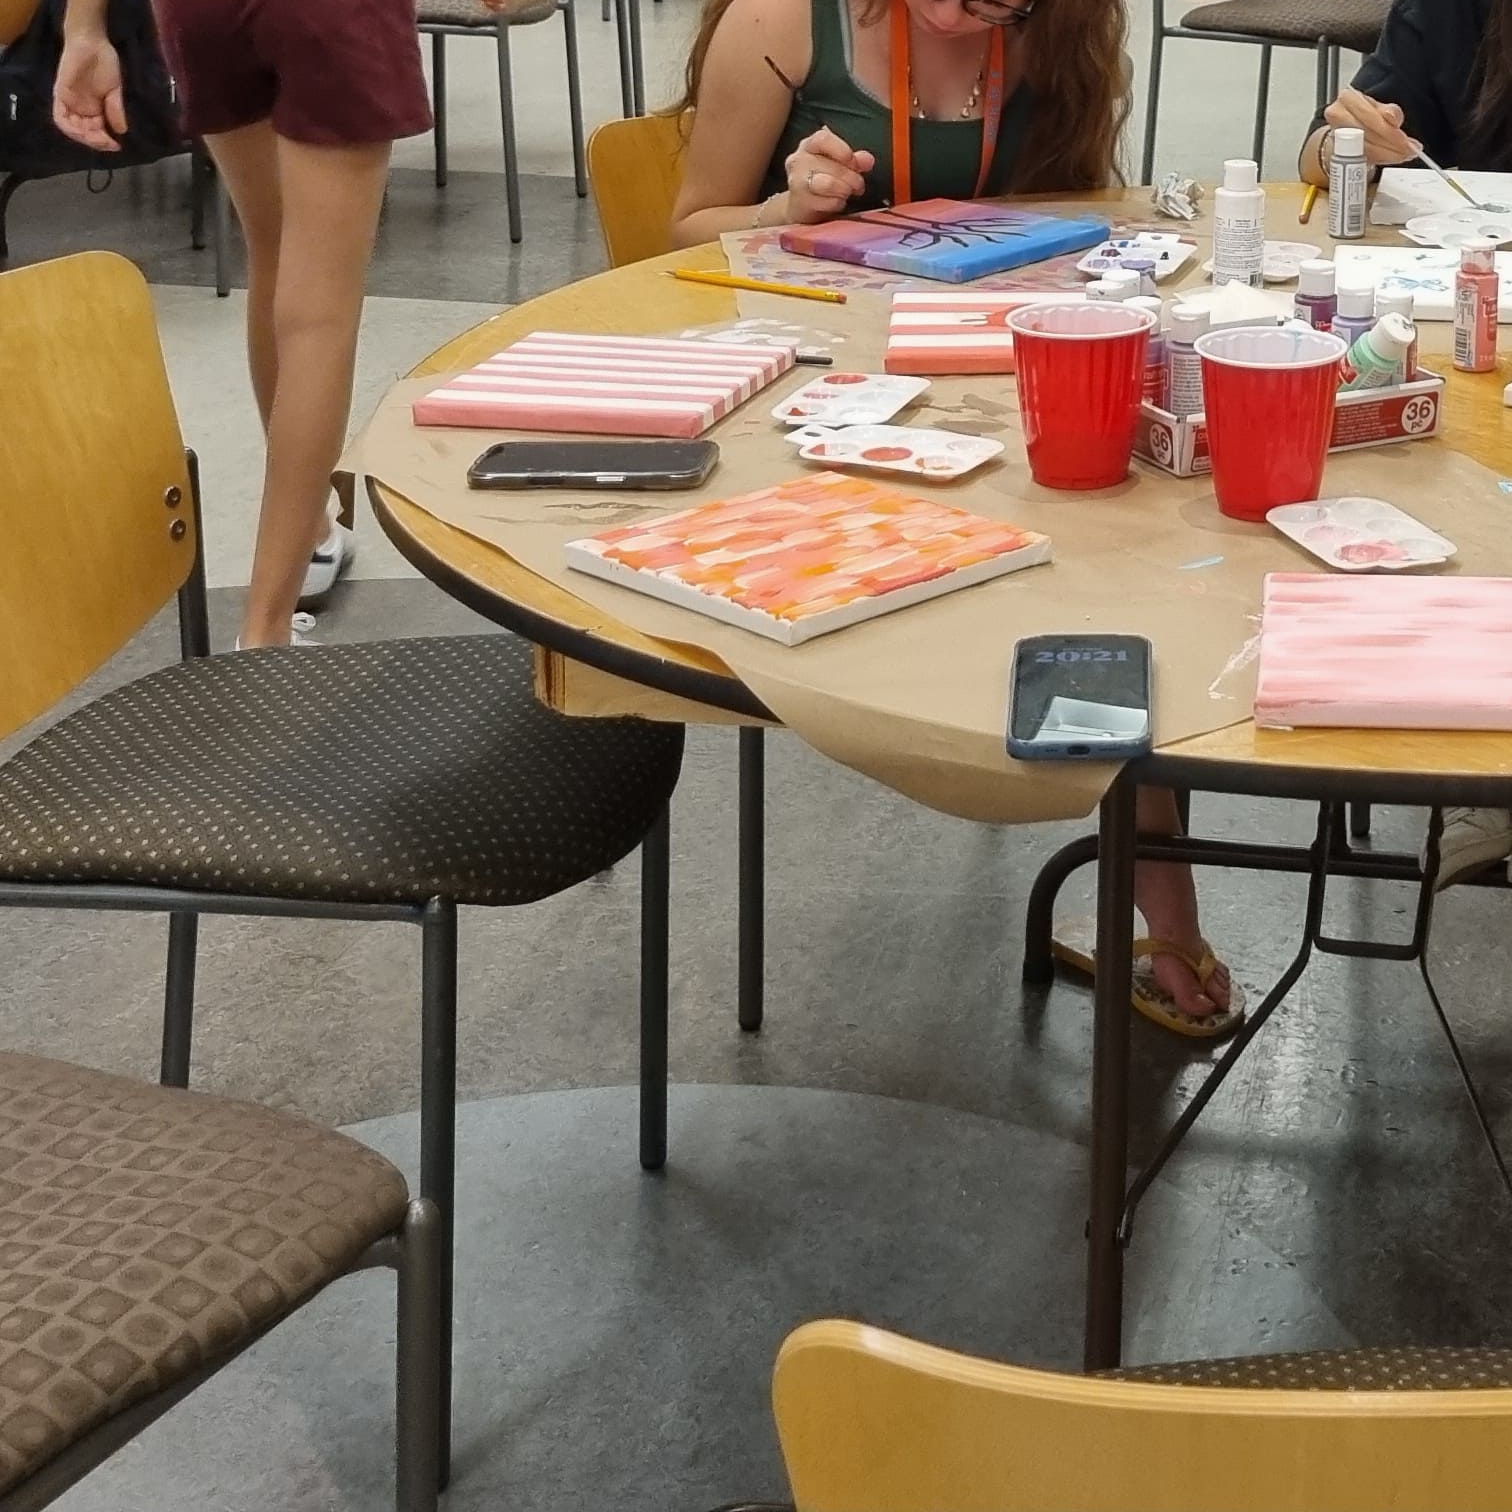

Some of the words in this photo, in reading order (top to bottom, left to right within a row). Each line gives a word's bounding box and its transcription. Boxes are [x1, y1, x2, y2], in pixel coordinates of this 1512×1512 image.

[1406, 399, 1431, 421] 36
[1152, 428, 1169, 452] 36
[1036, 651, 1127, 663] 20:21
